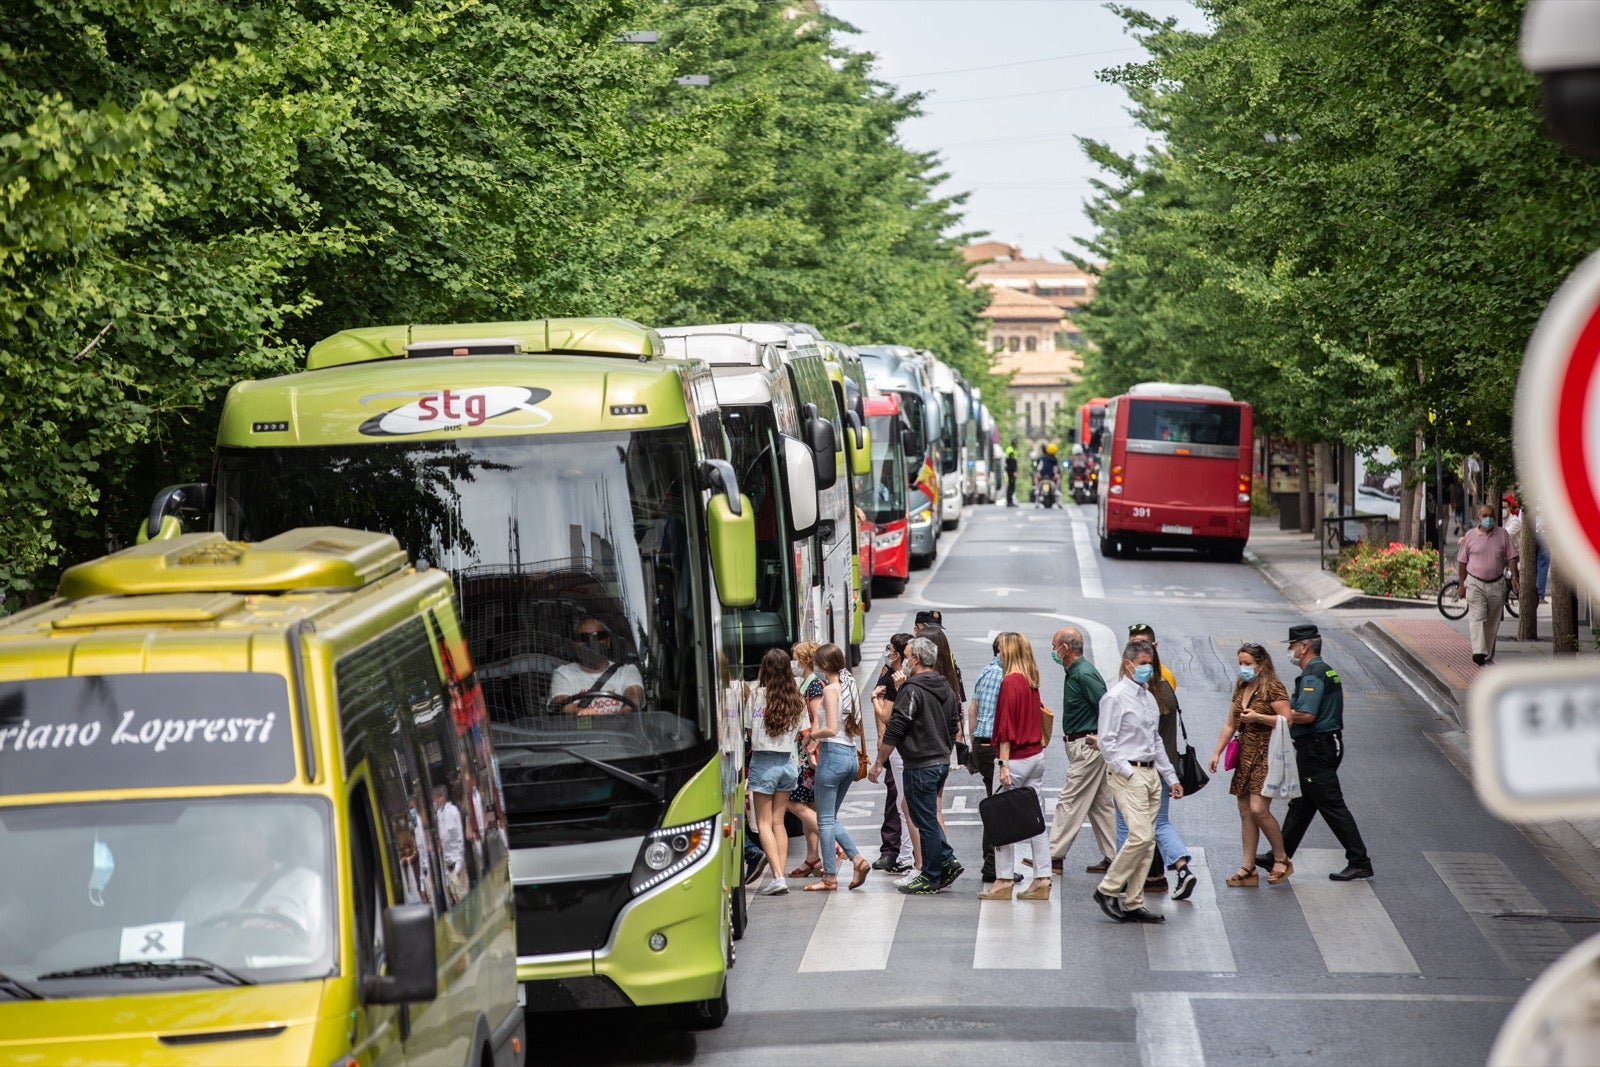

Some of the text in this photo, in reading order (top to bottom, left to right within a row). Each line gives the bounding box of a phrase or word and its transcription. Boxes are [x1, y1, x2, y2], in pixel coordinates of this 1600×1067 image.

[419, 390, 486, 426] stg
[1133, 507, 1150, 517] 391
[110, 709, 276, 753] Lopresti
